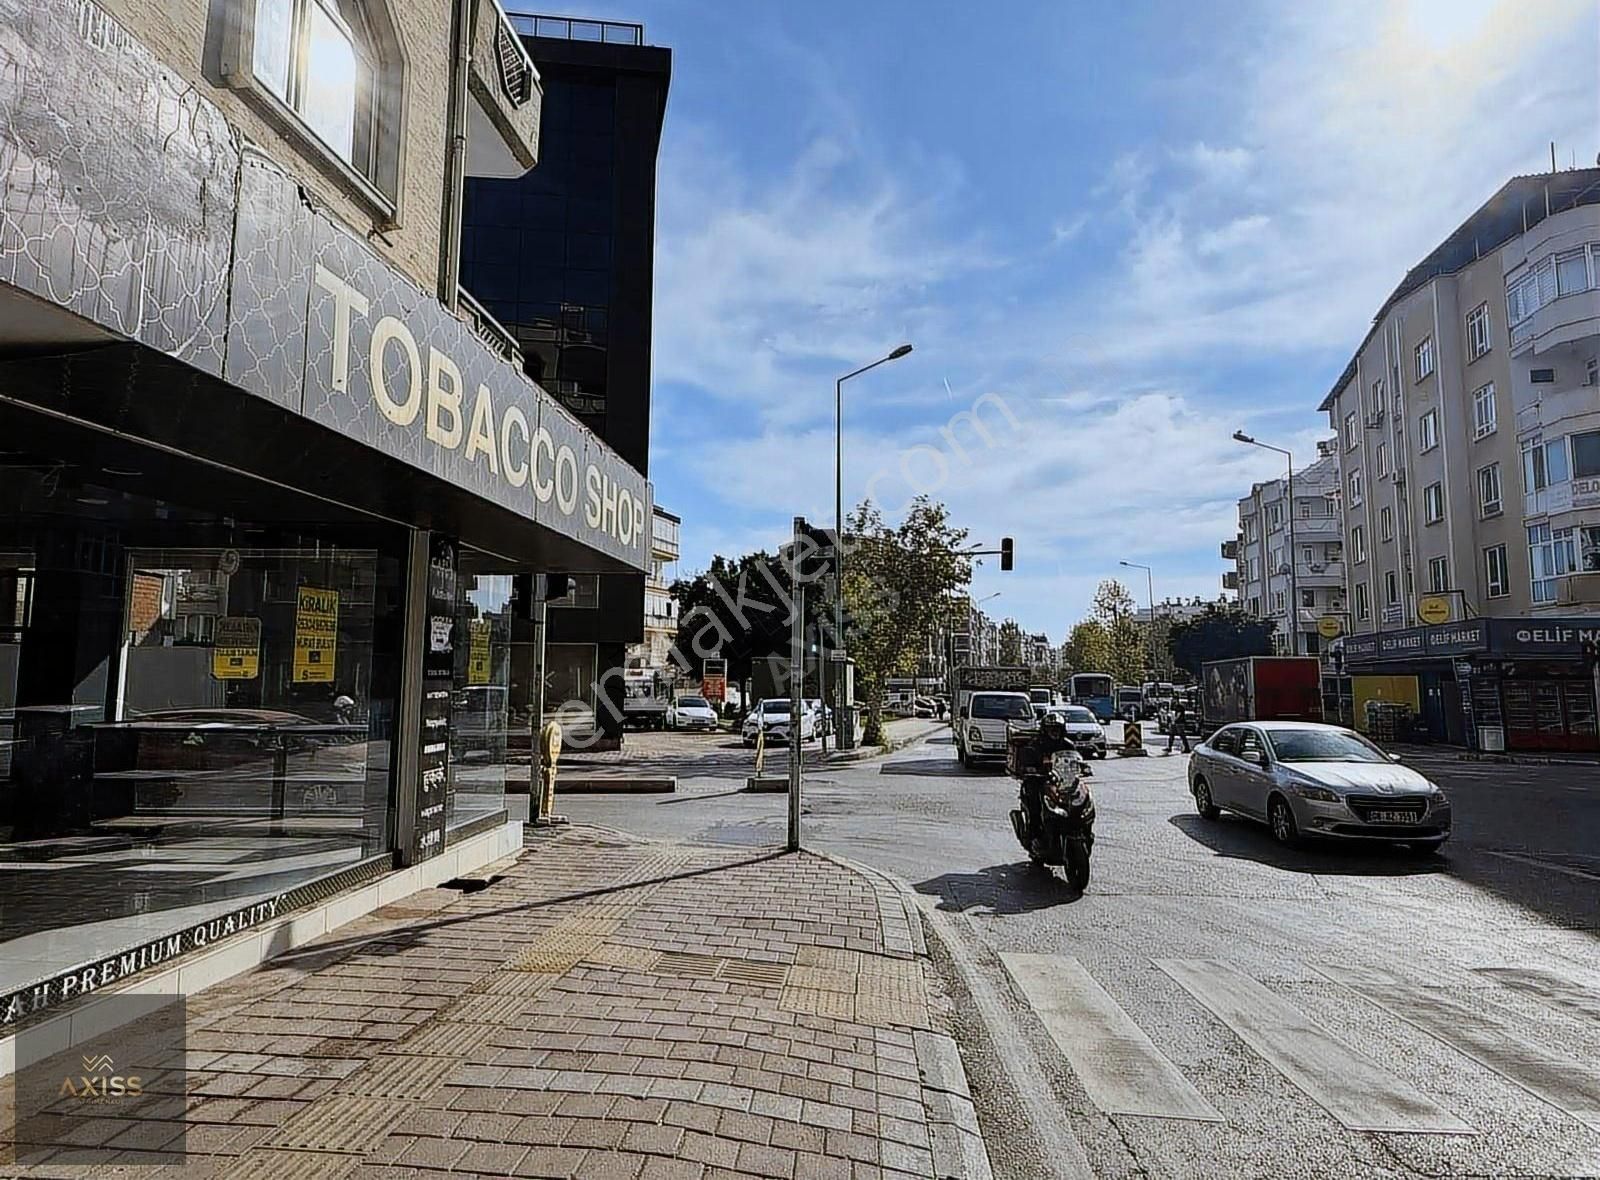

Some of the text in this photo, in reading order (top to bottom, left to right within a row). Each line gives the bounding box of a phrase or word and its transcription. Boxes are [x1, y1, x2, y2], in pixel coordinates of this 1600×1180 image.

[314, 263, 644, 549] TOBACCO SHOP
[62, 934, 183, 1000] PREMIUM
[194, 894, 280, 946] QUALITY
